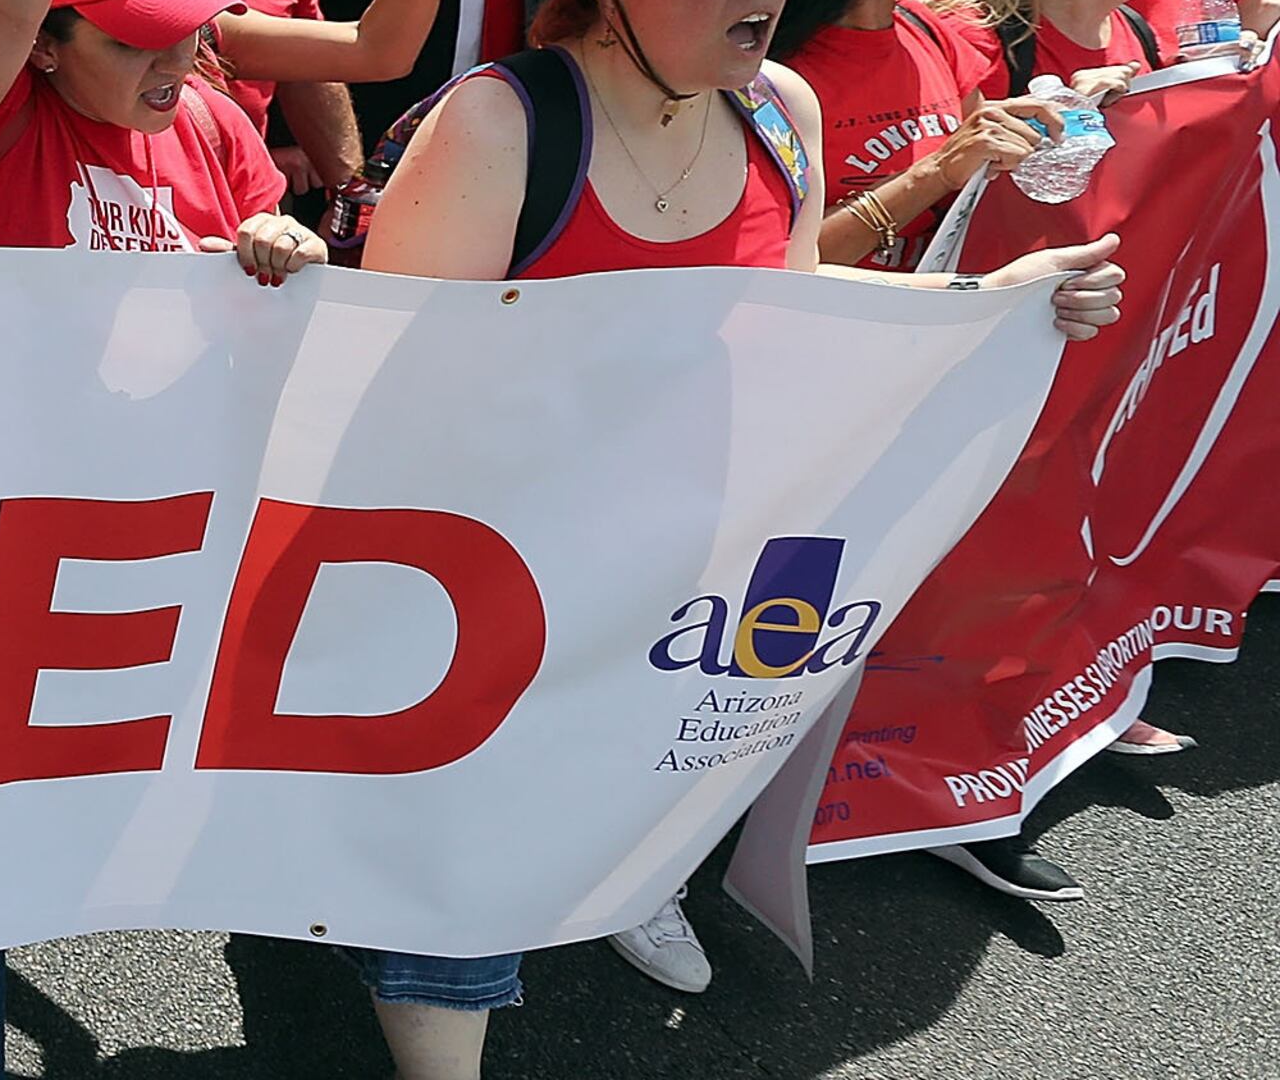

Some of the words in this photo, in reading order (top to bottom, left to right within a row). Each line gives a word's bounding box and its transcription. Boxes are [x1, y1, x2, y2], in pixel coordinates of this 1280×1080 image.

[844, 114, 961, 174] LONGHO
[87, 197, 124, 232] OUR
[648, 593, 883, 679] aea
[1151, 605, 1234, 637] OUR
[694, 689, 803, 713] Arizona
[676, 710, 801, 743] Education
[654, 731, 795, 772] Association
